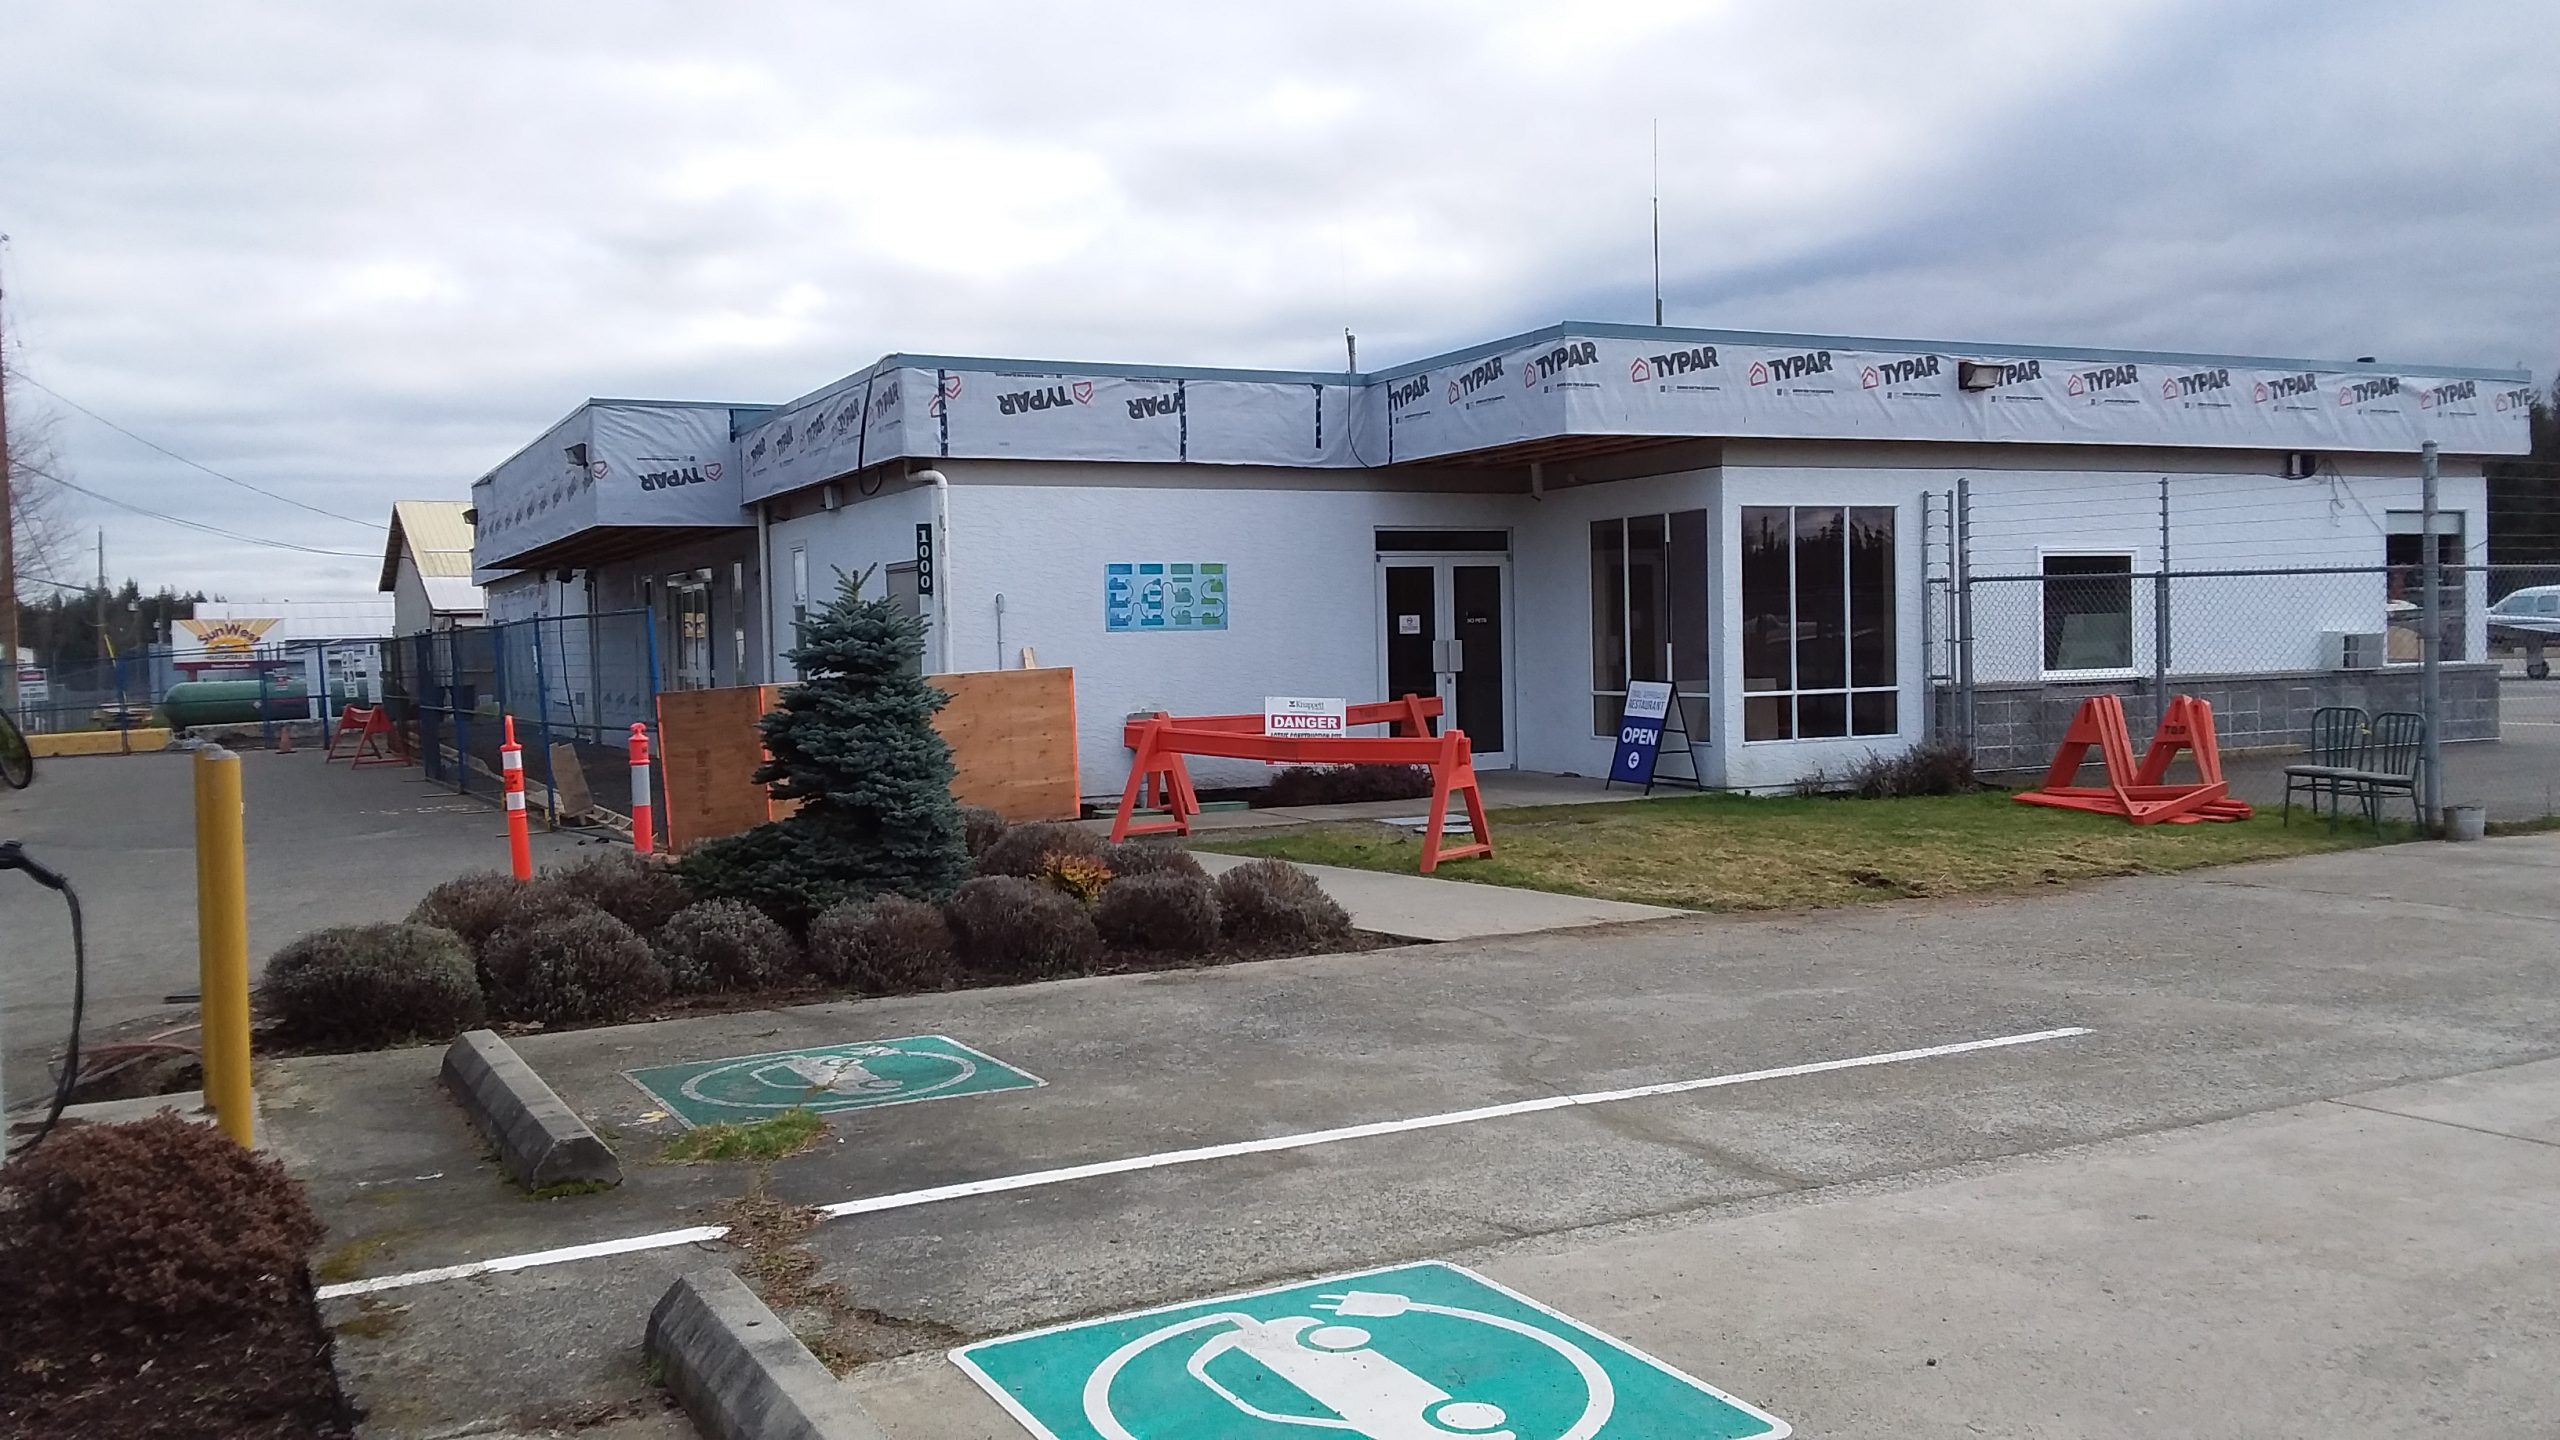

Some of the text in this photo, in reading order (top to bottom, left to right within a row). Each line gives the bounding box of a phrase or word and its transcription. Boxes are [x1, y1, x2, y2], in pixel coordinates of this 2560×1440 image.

[1535, 342, 1599, 378] TYPAR
[1649, 346, 1719, 377] TYPAR
[1768, 351, 1833, 381] TYPAR
[1879, 355, 1940, 385] TYPAR
[1999, 360, 2042, 387] YPAR
[1459, 356, 1504, 396] TYPAR
[2083, 365, 2138, 391] TYPAR
[2177, 369, 2231, 396] TYPAR
[2267, 373, 2317, 400] TYPAR
[997, 386, 1073, 415] TYPAR
[1390, 375, 1430, 411] TYPAR
[2352, 377, 2400, 403] TYPAR
[2433, 381, 2476, 407] TYPAR
[1126, 392, 1179, 419] YPAR
[640, 466, 705, 491] TYPAR
[919, 529, 930, 588] 1000
[1274, 716, 1338, 729] DANGER
[1622, 727, 1658, 746] OPEN
